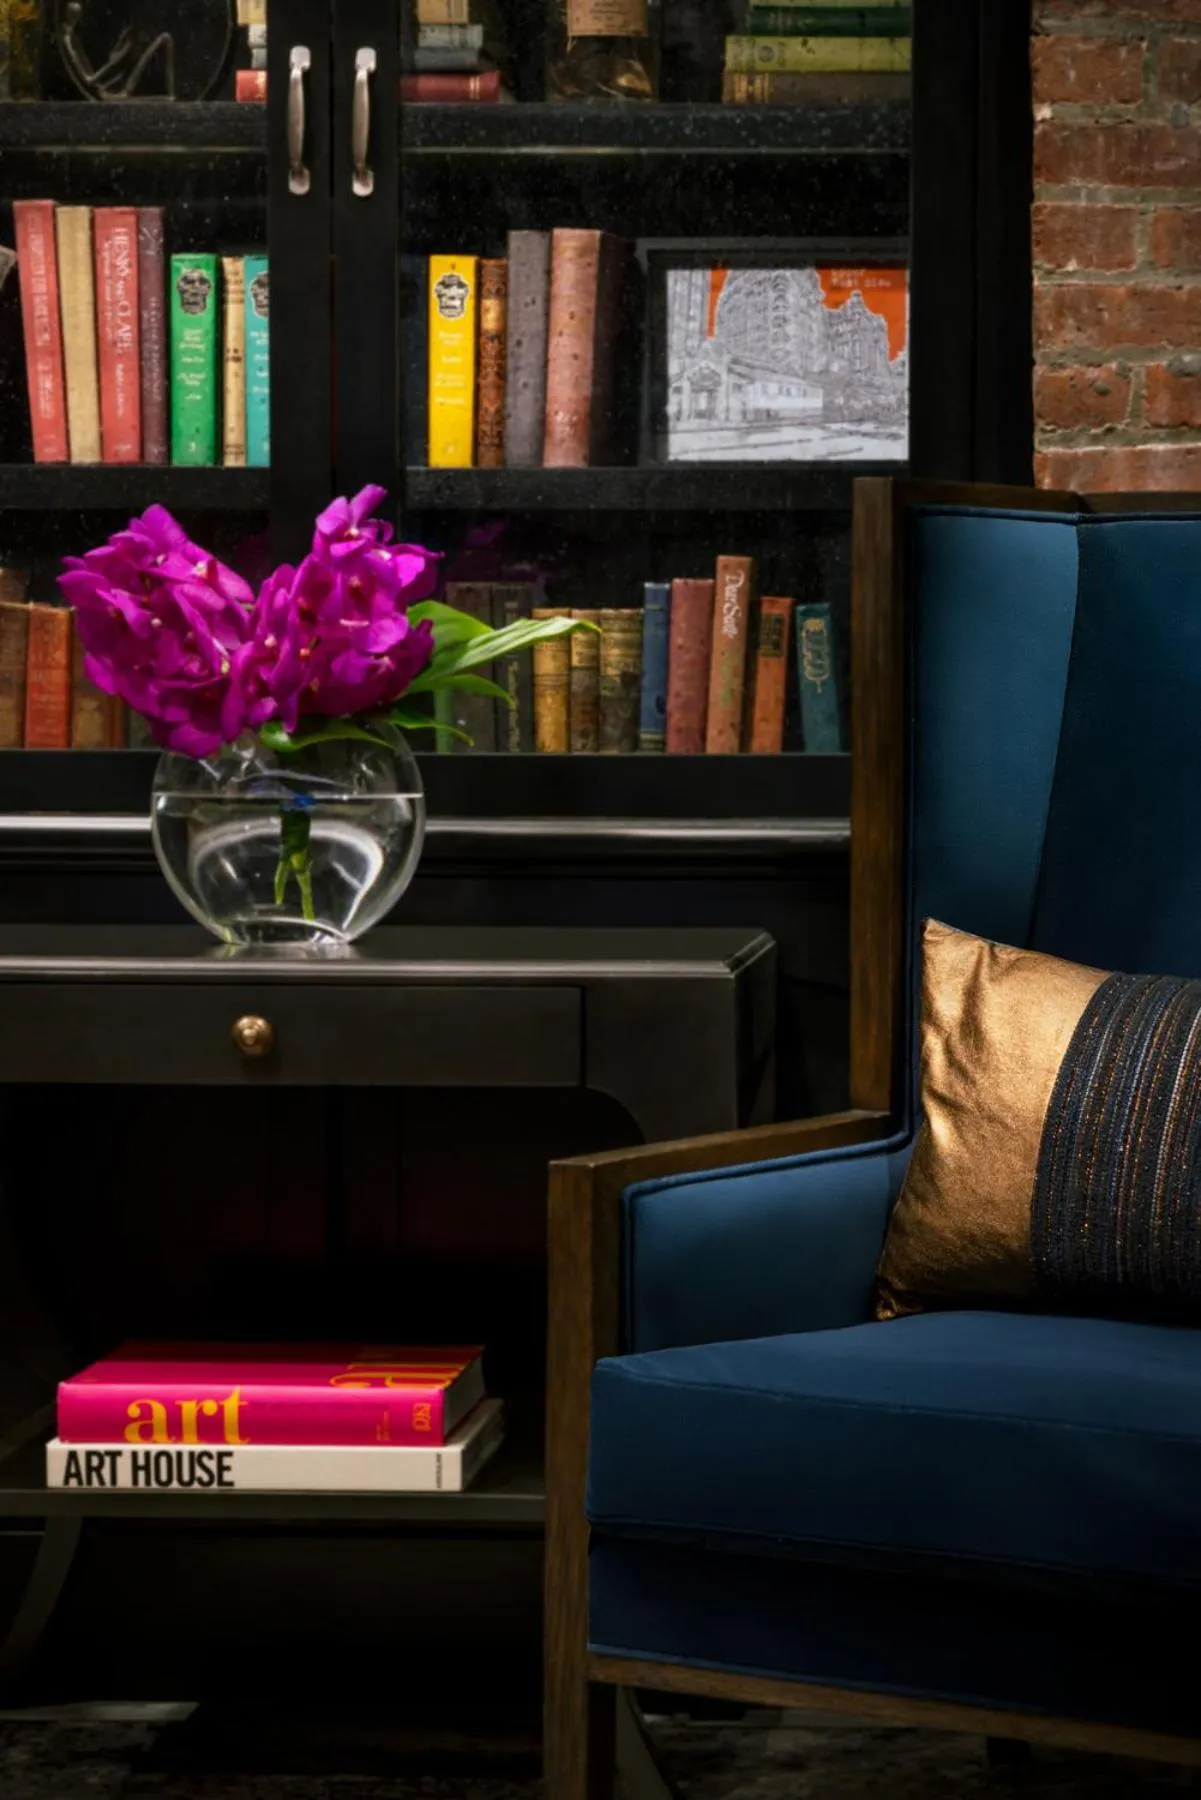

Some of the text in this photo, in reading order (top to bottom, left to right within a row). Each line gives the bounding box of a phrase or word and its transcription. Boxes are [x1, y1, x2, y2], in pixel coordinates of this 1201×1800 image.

[124, 1385, 250, 1444] art
[63, 1450, 234, 1487] ART HOUSE
